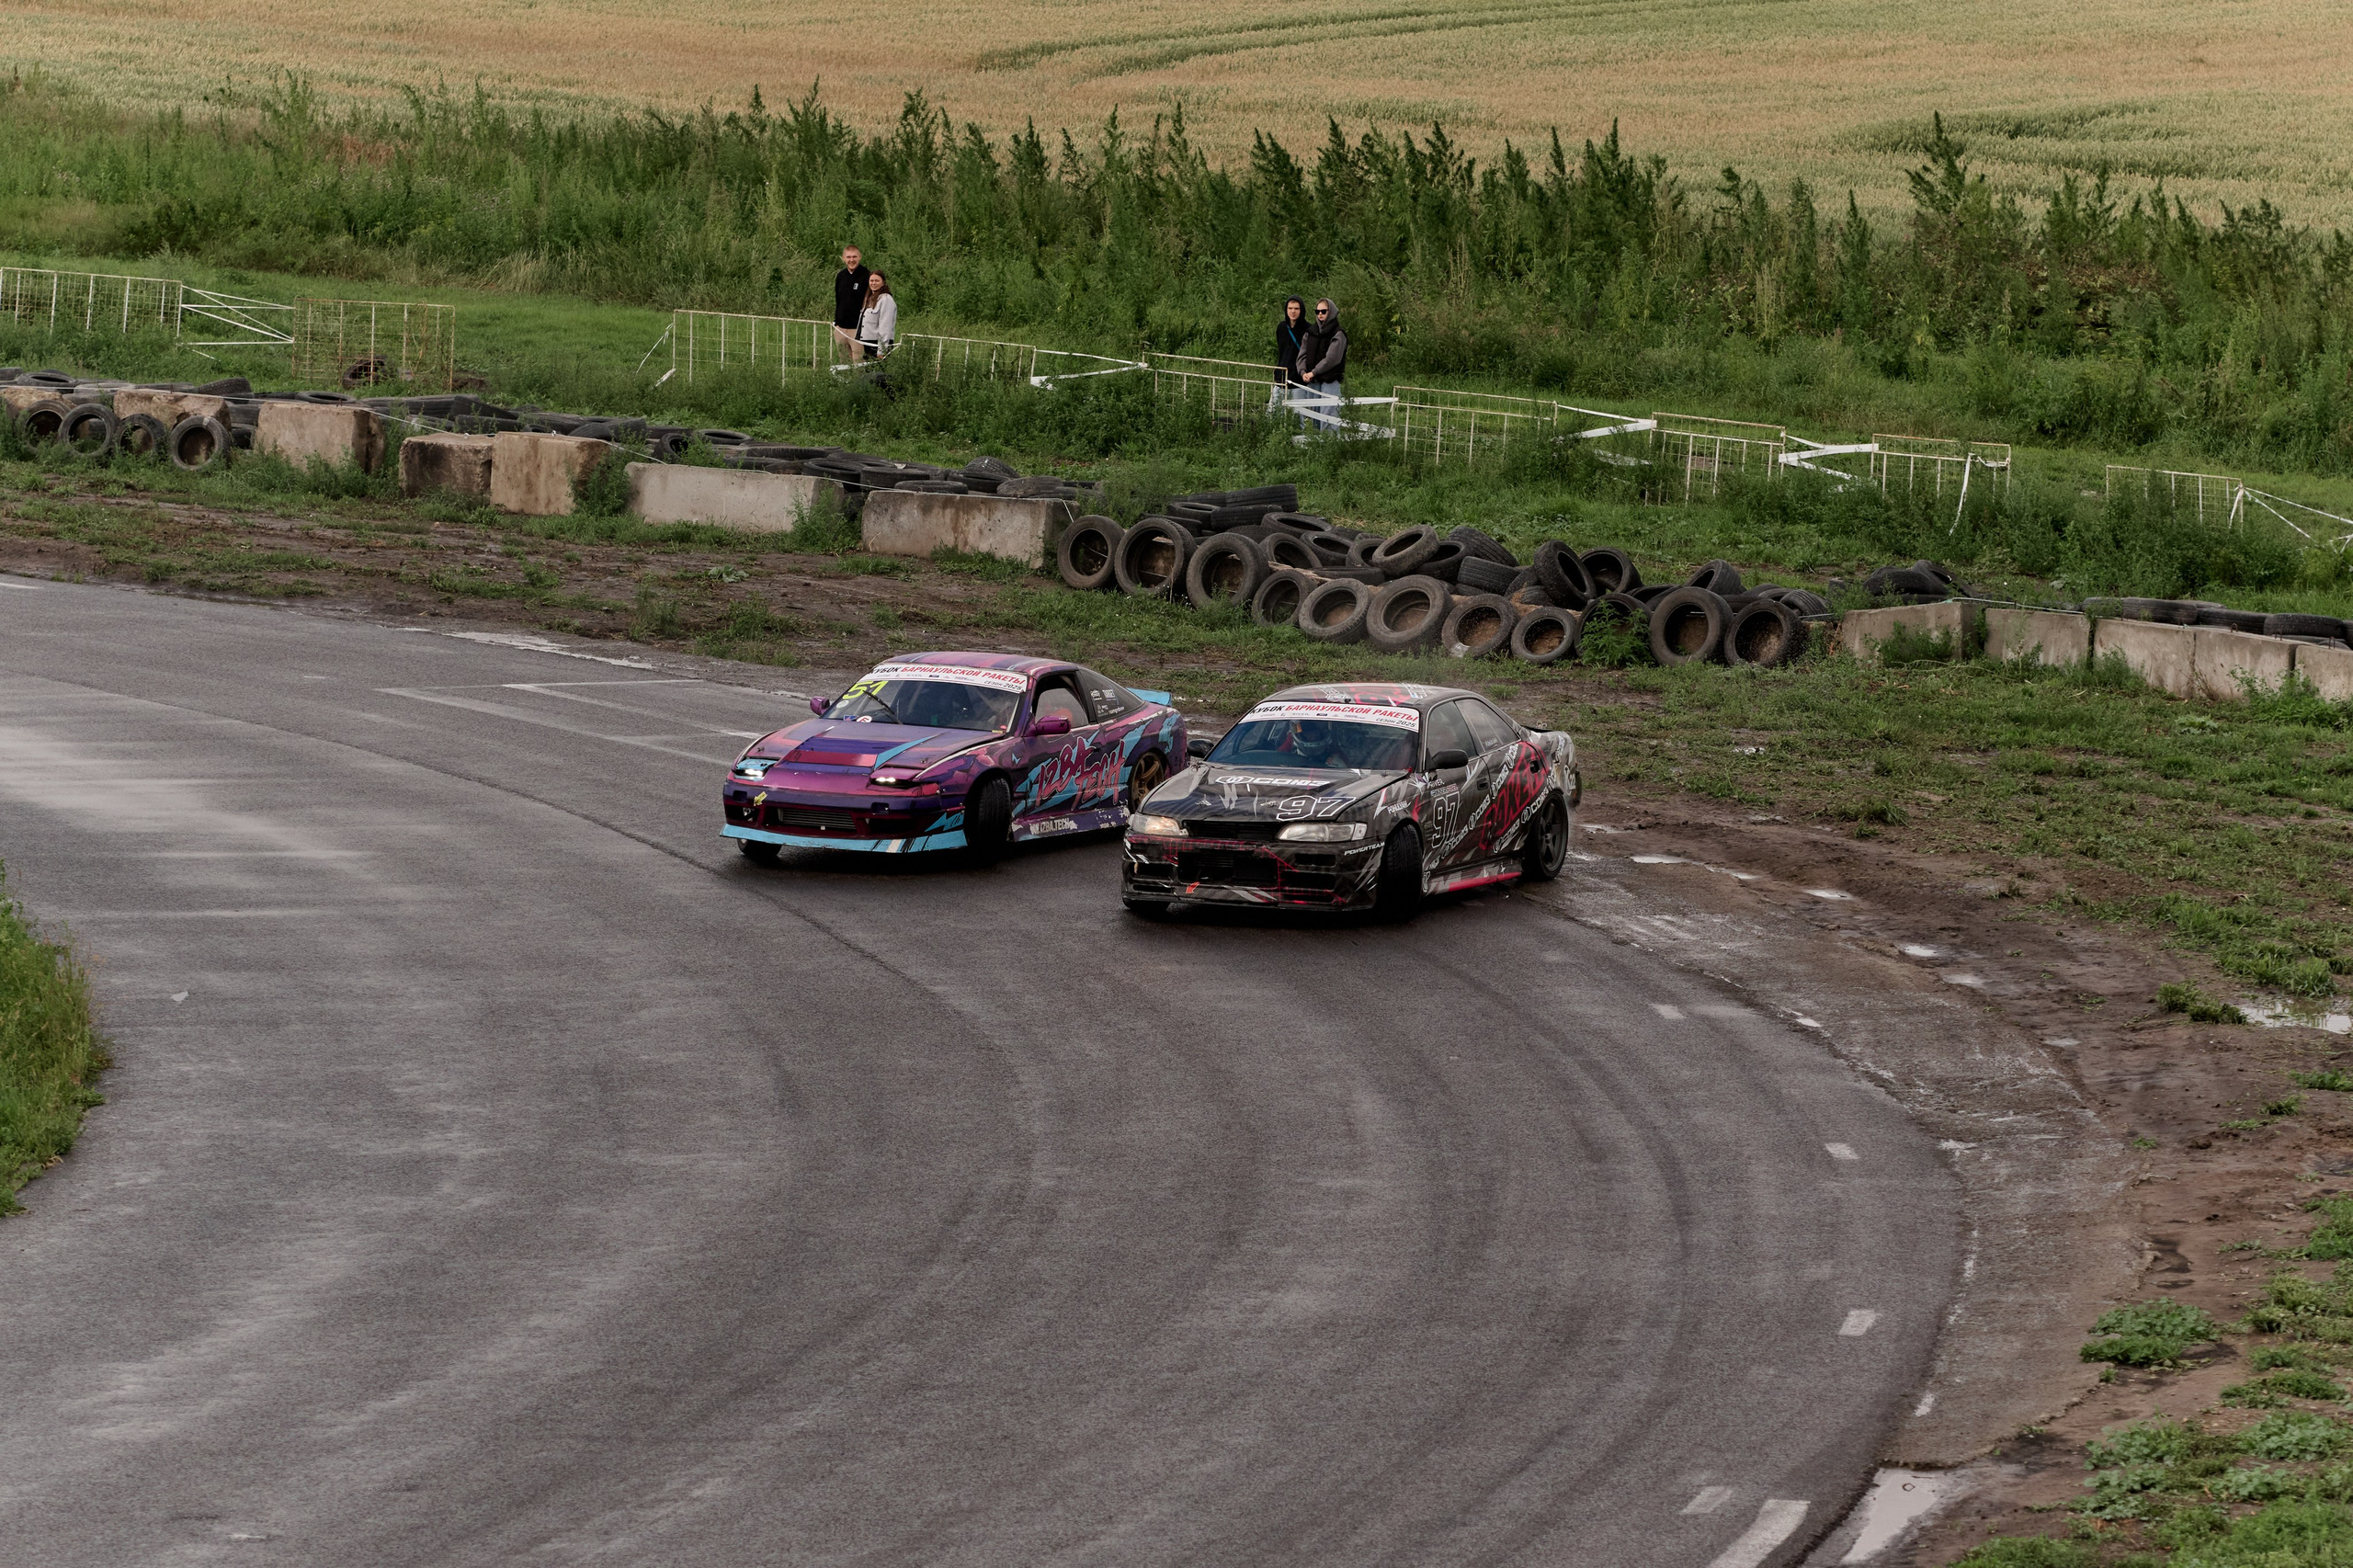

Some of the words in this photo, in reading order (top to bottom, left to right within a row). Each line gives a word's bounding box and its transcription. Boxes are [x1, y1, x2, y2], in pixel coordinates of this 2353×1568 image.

[901, 666, 982, 677] БАРНАУЛЬСКОЙ
[982, 668, 1026, 685] РАКЕТЫ
[842, 680, 889, 700] 51
[1003, 683, 1022, 691] 2025
[1285, 704, 1371, 714] БАРНАУЛЬСКОЙ
[1372, 709, 1418, 722] РАКЕТЫ
[1396, 720, 1416, 728] 2025
[1253, 777, 1331, 786] СОЮЗ
[1276, 795, 1358, 822] 97
[1431, 790, 1461, 849] 97
[1344, 841, 1385, 856] POWERTEAM
